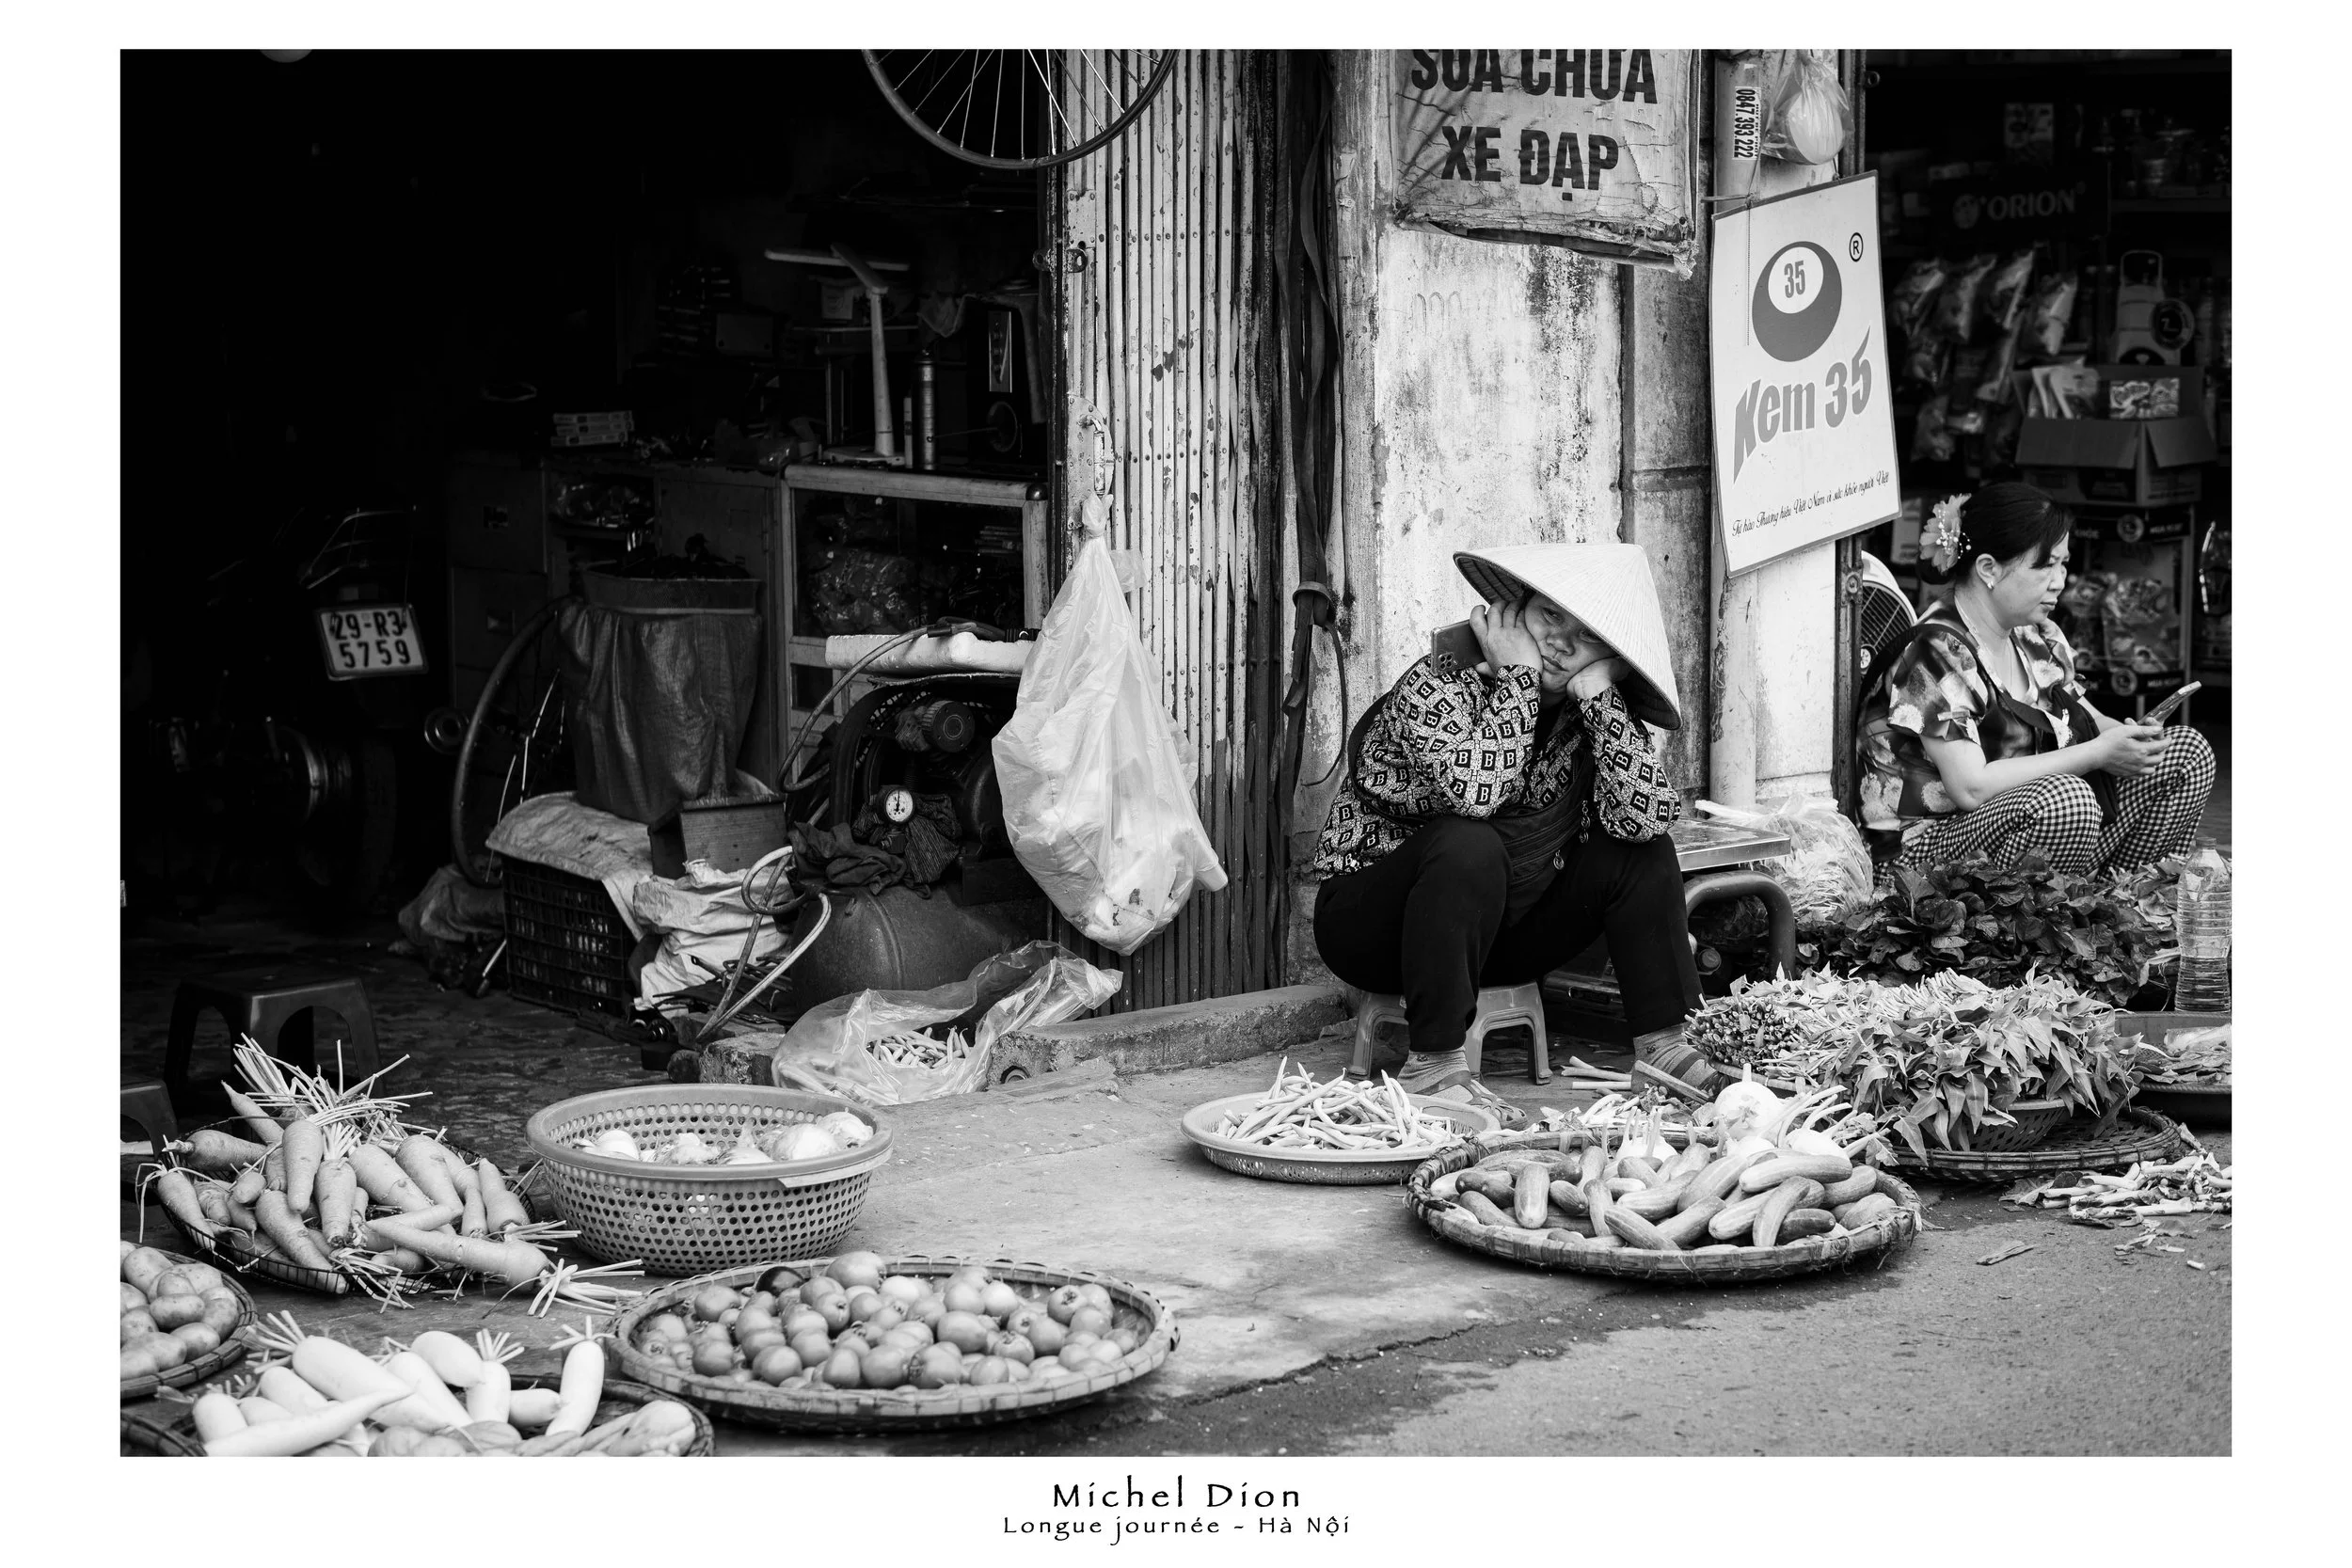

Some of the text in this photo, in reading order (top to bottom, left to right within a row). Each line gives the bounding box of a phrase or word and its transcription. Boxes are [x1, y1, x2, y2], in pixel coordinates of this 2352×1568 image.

[1734, 88, 1756, 158] 0847.393.222
[1441, 126, 1619, 201] XE ĐẠP
[1987, 189, 2076, 221] ORION
[1784, 260, 1806, 298] 35
[1734, 325, 1872, 484] Kem 35
[1807, 490, 1826, 511] Nam
[335, 610, 405, 641] 29-R3
[339, 640, 410, 669] 5759
